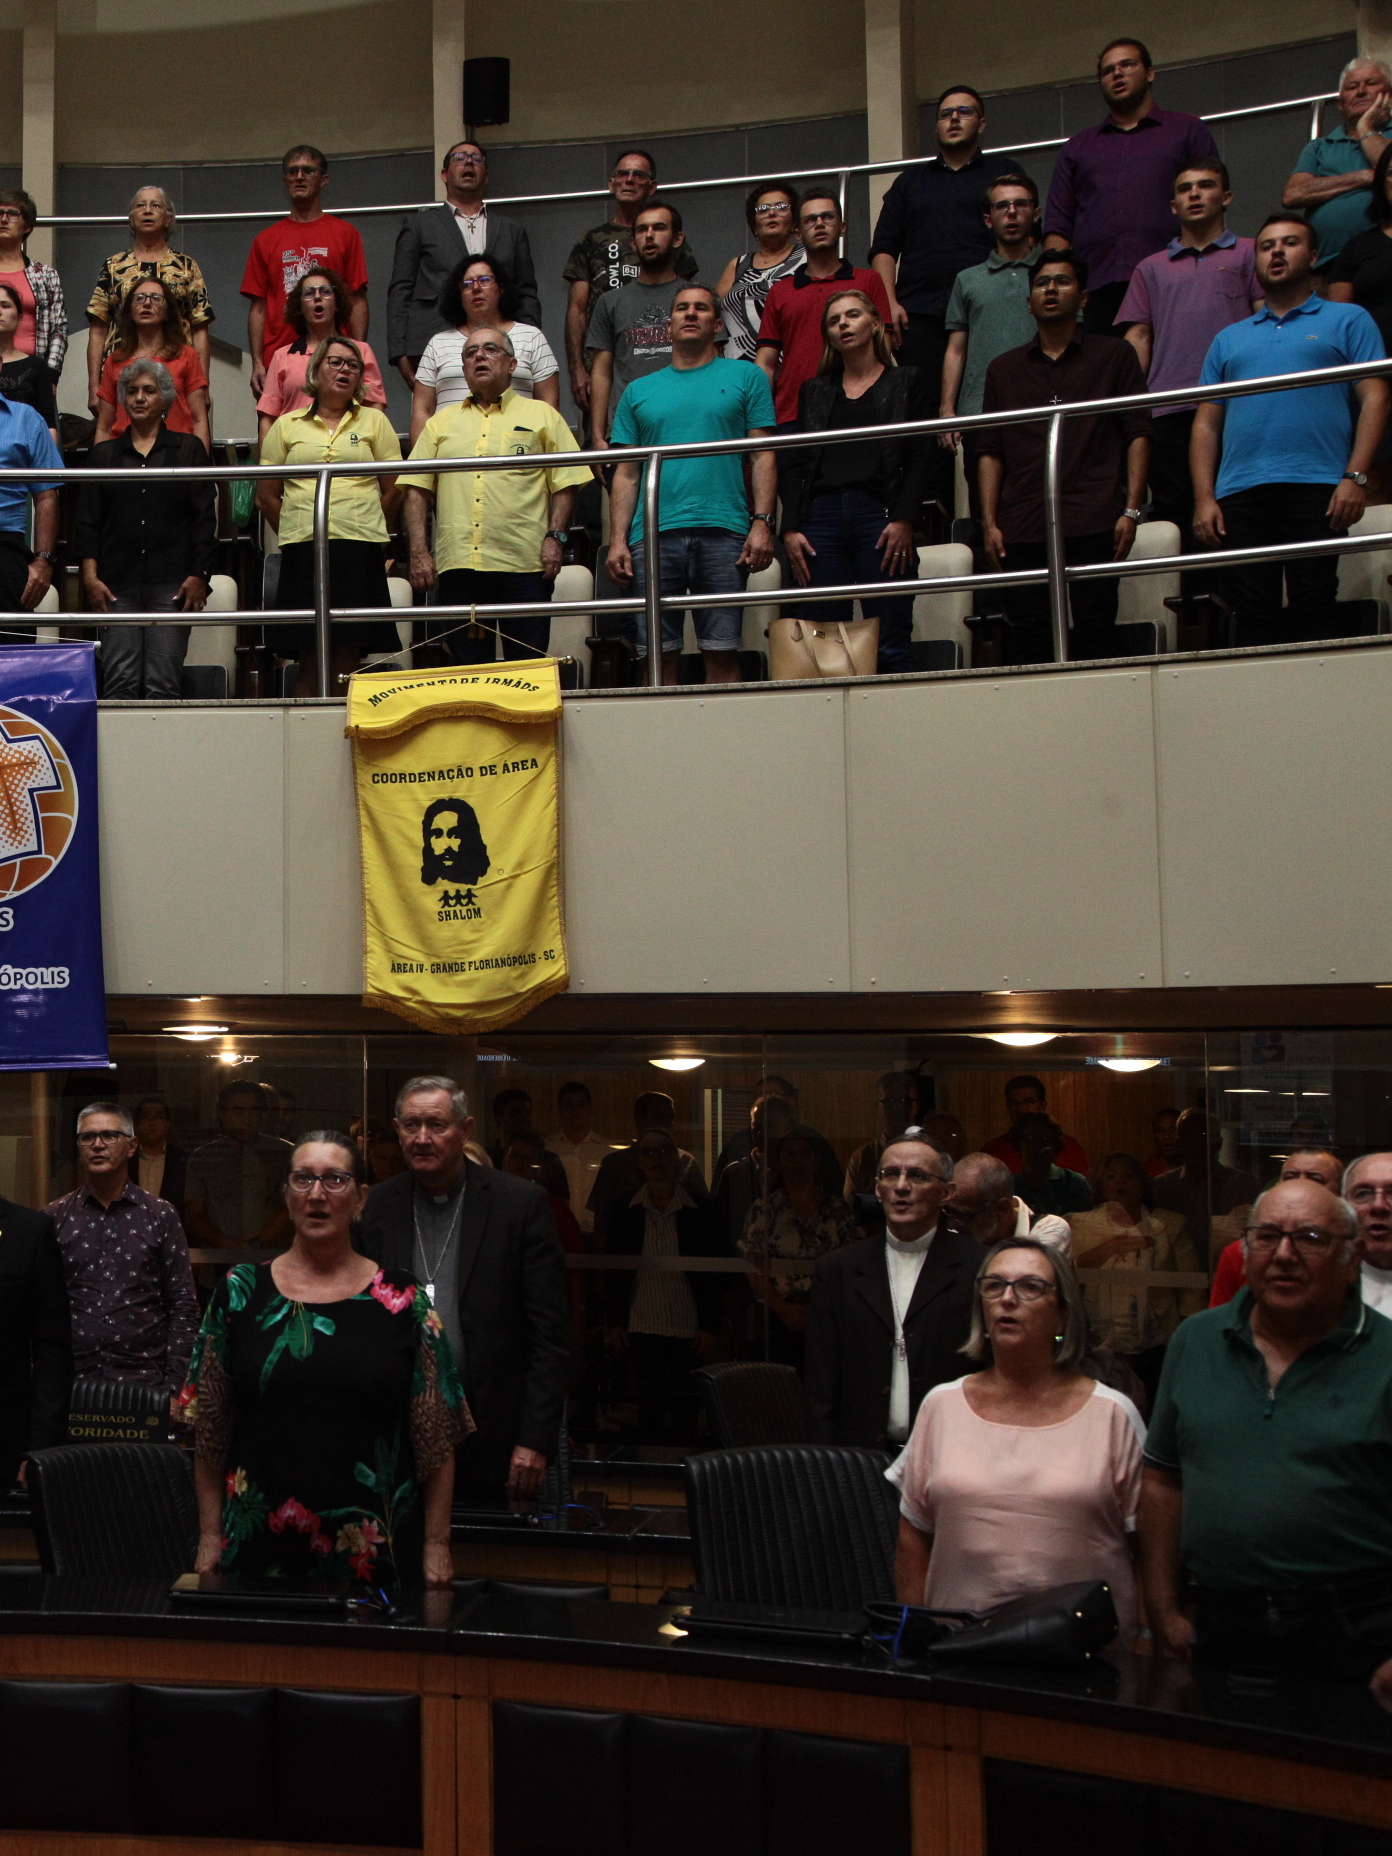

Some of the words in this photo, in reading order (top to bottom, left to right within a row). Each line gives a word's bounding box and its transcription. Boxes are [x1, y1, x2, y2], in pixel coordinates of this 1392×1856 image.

[608, 239, 619, 259] CO.
[371, 765, 474, 784] COORDENAÇÃO
[479, 764, 498, 777] DE
[501, 758, 539, 774] ÁREA
[436, 907, 483, 922] SHALOM
[390, 960, 414, 973] ÁREA
[430, 961, 466, 974] GRANDE
[468, 953, 536, 971] FLORIANÓPOLIS
[543, 949, 556, 961] SC
[67, 1413, 136, 1424] ESERVADO
